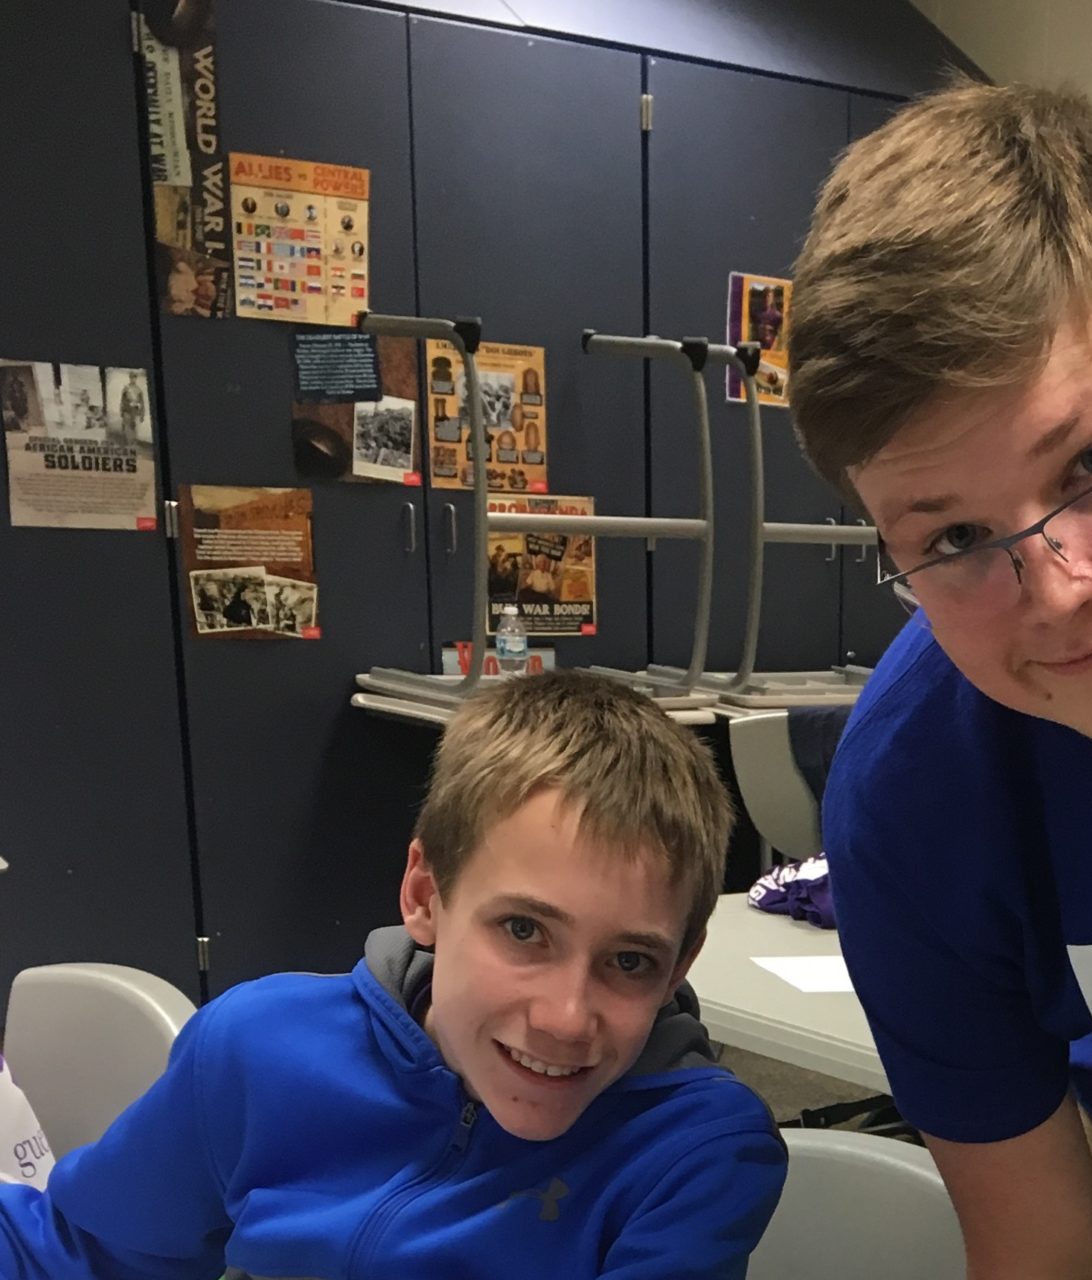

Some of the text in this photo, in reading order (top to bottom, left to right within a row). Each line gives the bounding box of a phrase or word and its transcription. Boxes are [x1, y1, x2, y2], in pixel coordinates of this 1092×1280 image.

[193, 45, 217, 154] WORLD
[234, 160, 293, 182] ALLIES
[202, 162, 225, 232] WAR
[25, 442, 74, 454] AFRICAN
[43, 453, 138, 473] SOLDIERS
[522, 603, 550, 616] WAR
